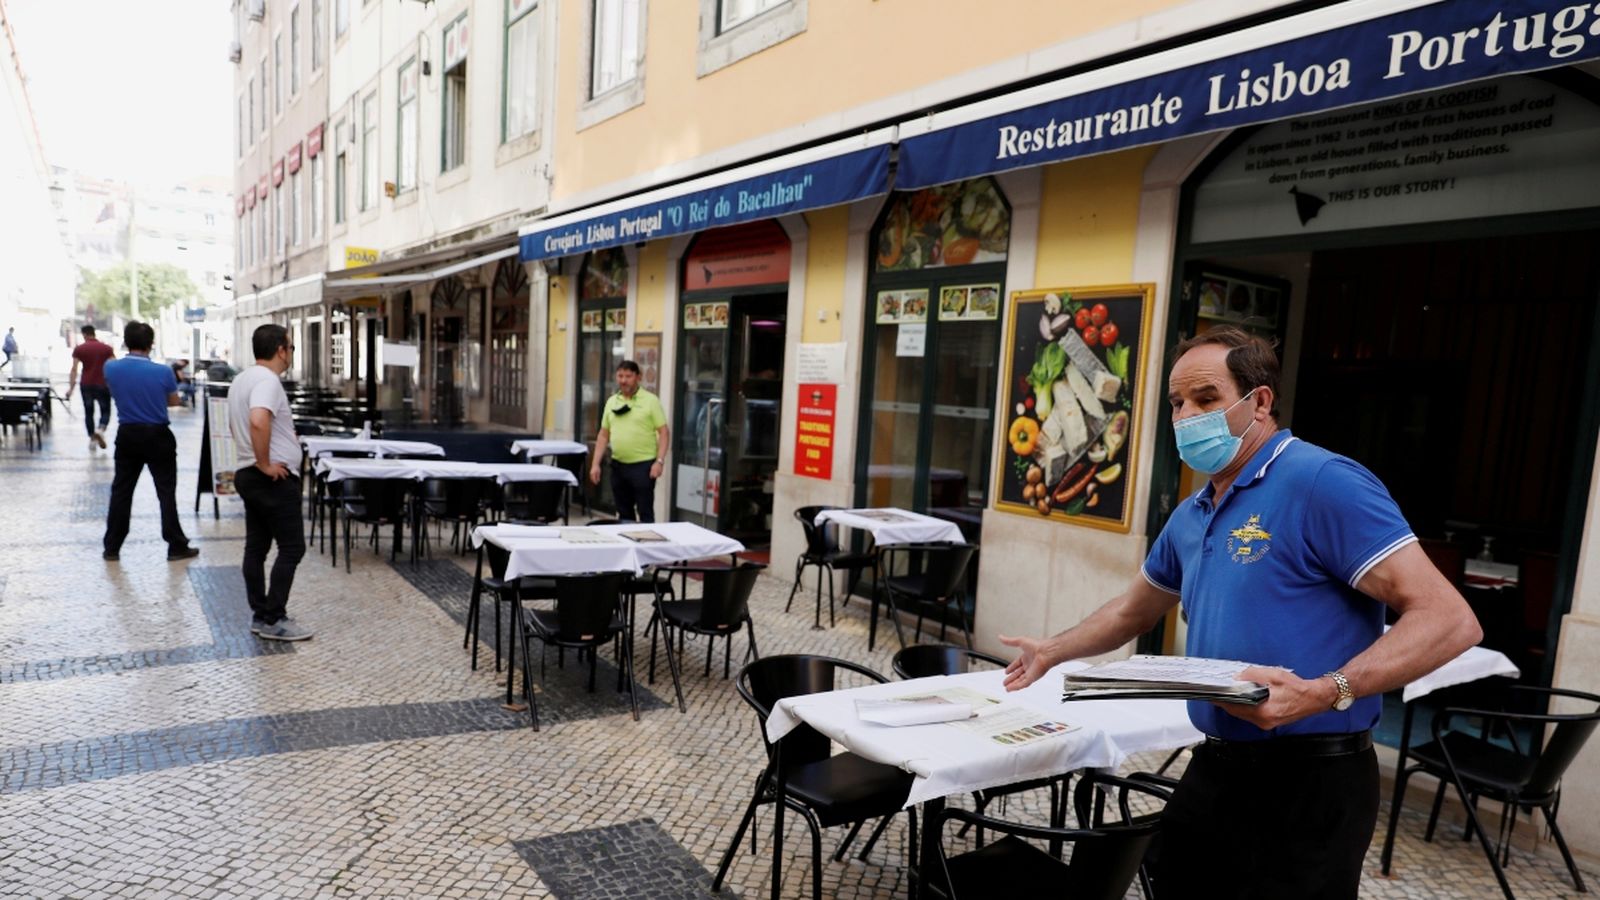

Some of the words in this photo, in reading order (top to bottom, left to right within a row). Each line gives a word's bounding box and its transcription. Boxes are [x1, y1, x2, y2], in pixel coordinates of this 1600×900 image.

[996, 92, 1183, 160] Restaurante
[1204, 57, 1350, 117] Lisboa
[1247, 144, 1255, 155] is
[1257, 142, 1282, 156] open
[1286, 138, 1311, 149] since
[1315, 131, 1341, 144] 1962
[1346, 129, 1356, 140] is
[1358, 126, 1380, 137] one
[1383, 121, 1397, 134] of
[1399, 118, 1420, 131] the
[1422, 113, 1454, 128] firsts
[1457, 105, 1507, 122] houses
[1509, 98, 1526, 113] of
[1527, 94, 1556, 110] cod
[1290, 121, 1309, 133] The
[1311, 109, 1371, 129] restaurant
[1373, 102, 1403, 120] KING
[1406, 98, 1422, 113] OF
[1425, 96, 1435, 109] A
[1438, 84, 1499, 107] CODFISH
[1244, 161, 1255, 172] in
[1256, 156, 1293, 171] Lisbon,
[1295, 154, 1308, 165] an
[1310, 151, 1329, 162] old
[1330, 145, 1365, 159] house
[1367, 139, 1398, 154] filled
[1400, 134, 1429, 148] with
[1432, 125, 1498, 144] traditions
[1501, 114, 1554, 137] passed
[1268, 171, 1297, 184] down
[1300, 168, 1326, 180] from
[1328, 157, 1401, 179] generations,
[1404, 150, 1445, 168] family
[1447, 142, 1510, 161] business.
[544, 228, 583, 253] Cervejaria
[586, 222, 615, 245] Lisboa
[620, 210, 662, 239] Portugal
[689, 205, 709, 223] Rei
[714, 196, 730, 218] do
[738, 175, 813, 214] Bacalhau"
[1328, 190, 1355, 202] THIS
[1358, 188, 1370, 199] IS
[1373, 184, 1401, 198] OUR
[1405, 178, 1447, 195] STORY
